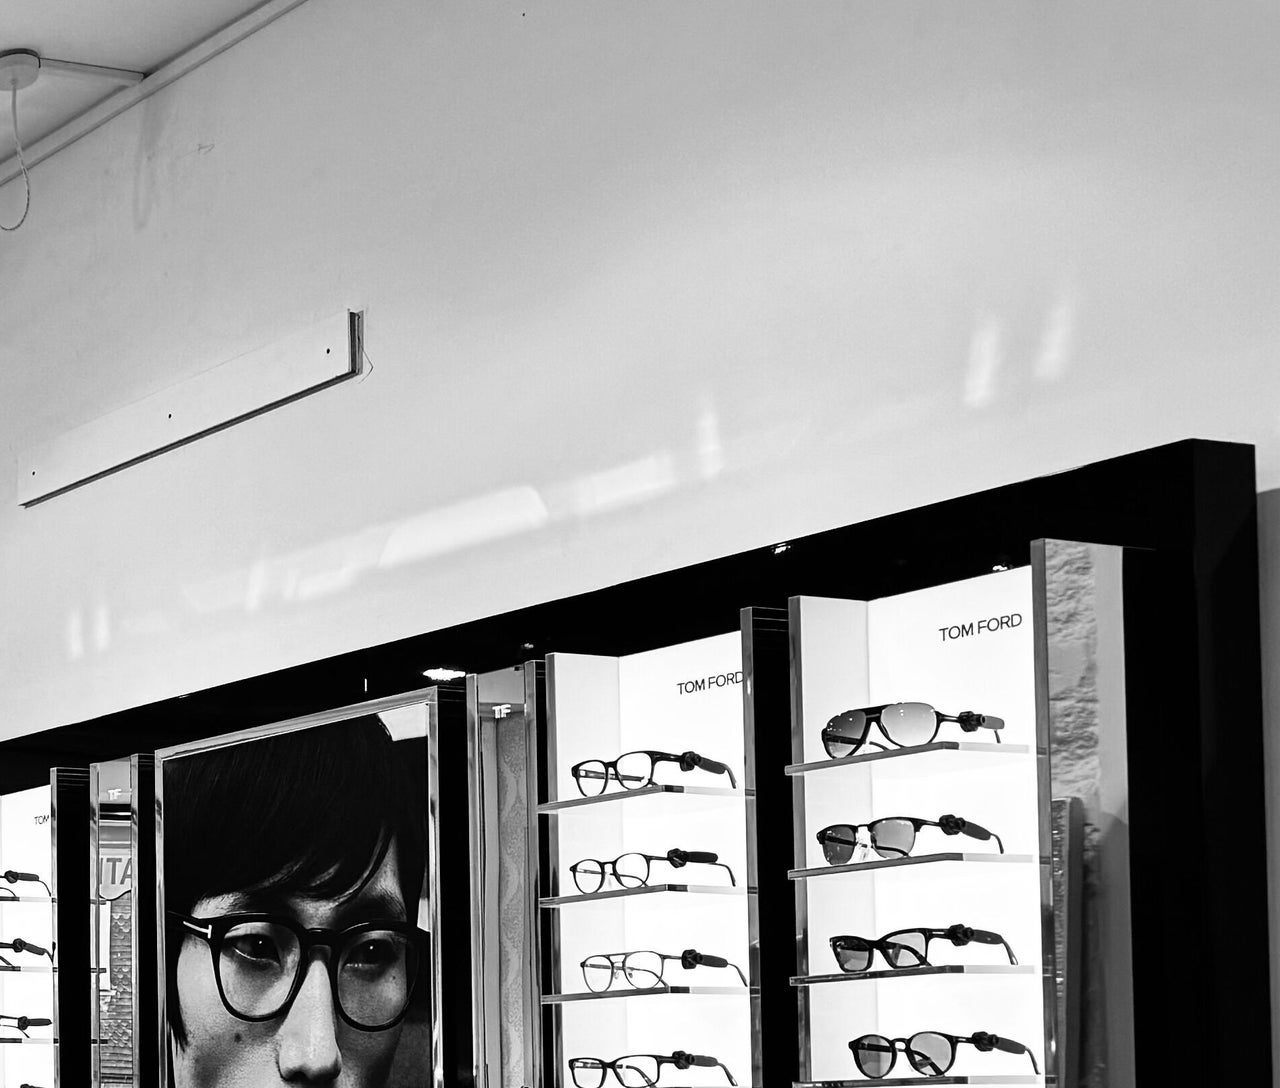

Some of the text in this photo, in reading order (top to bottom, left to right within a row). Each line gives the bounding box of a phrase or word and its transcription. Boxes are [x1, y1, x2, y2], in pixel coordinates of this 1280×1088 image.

[938, 613, 1022, 642] TOM FORD
[676, 671, 744, 695] TOM FORD
[491, 703, 512, 719] TF
